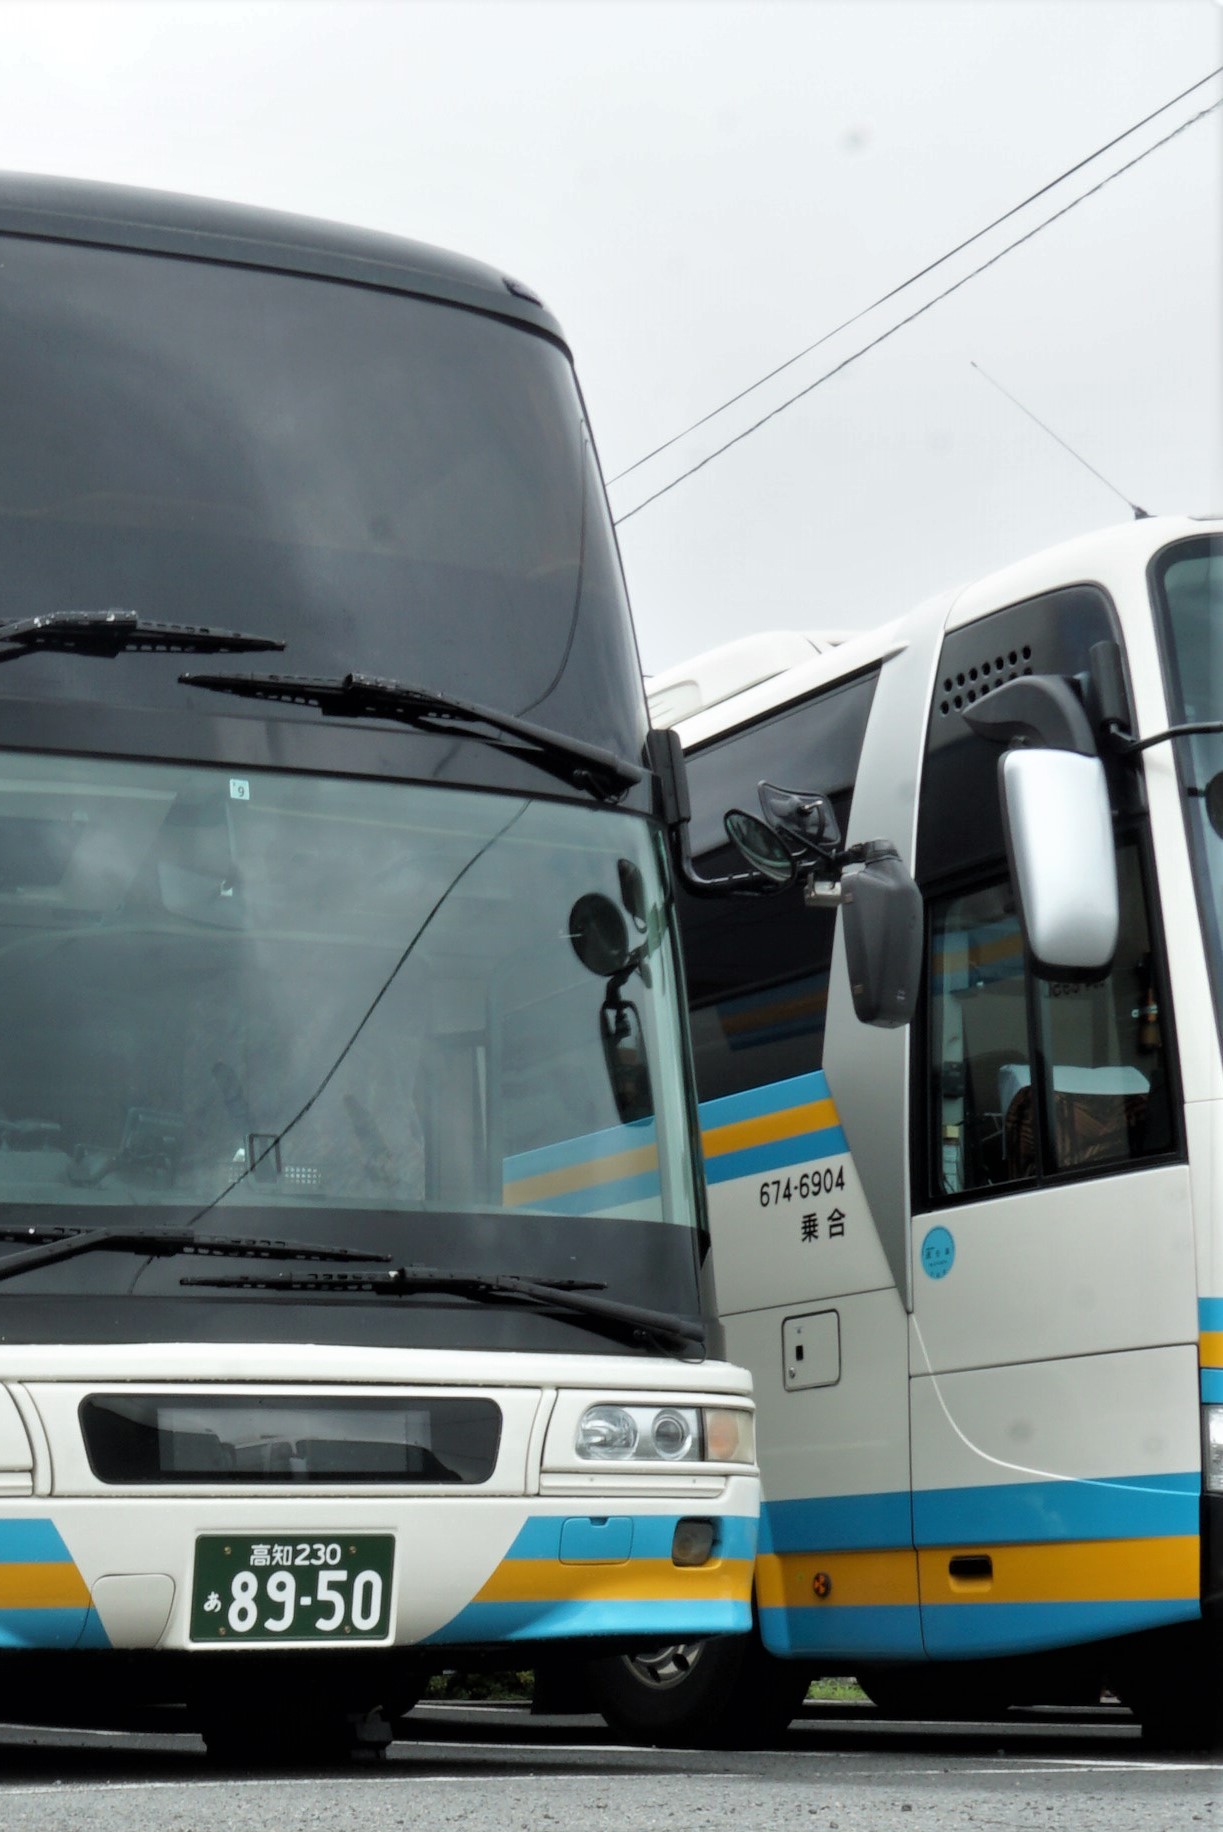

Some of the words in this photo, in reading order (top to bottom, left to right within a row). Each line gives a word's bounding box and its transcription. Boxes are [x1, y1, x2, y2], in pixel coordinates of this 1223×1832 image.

[801, 1208, 845, 1242] 乗合
[249, 1543, 342, 1566] 高知230
[203, 1591, 222, 1612] あ
[228, 1570, 383, 1632] 89-50
